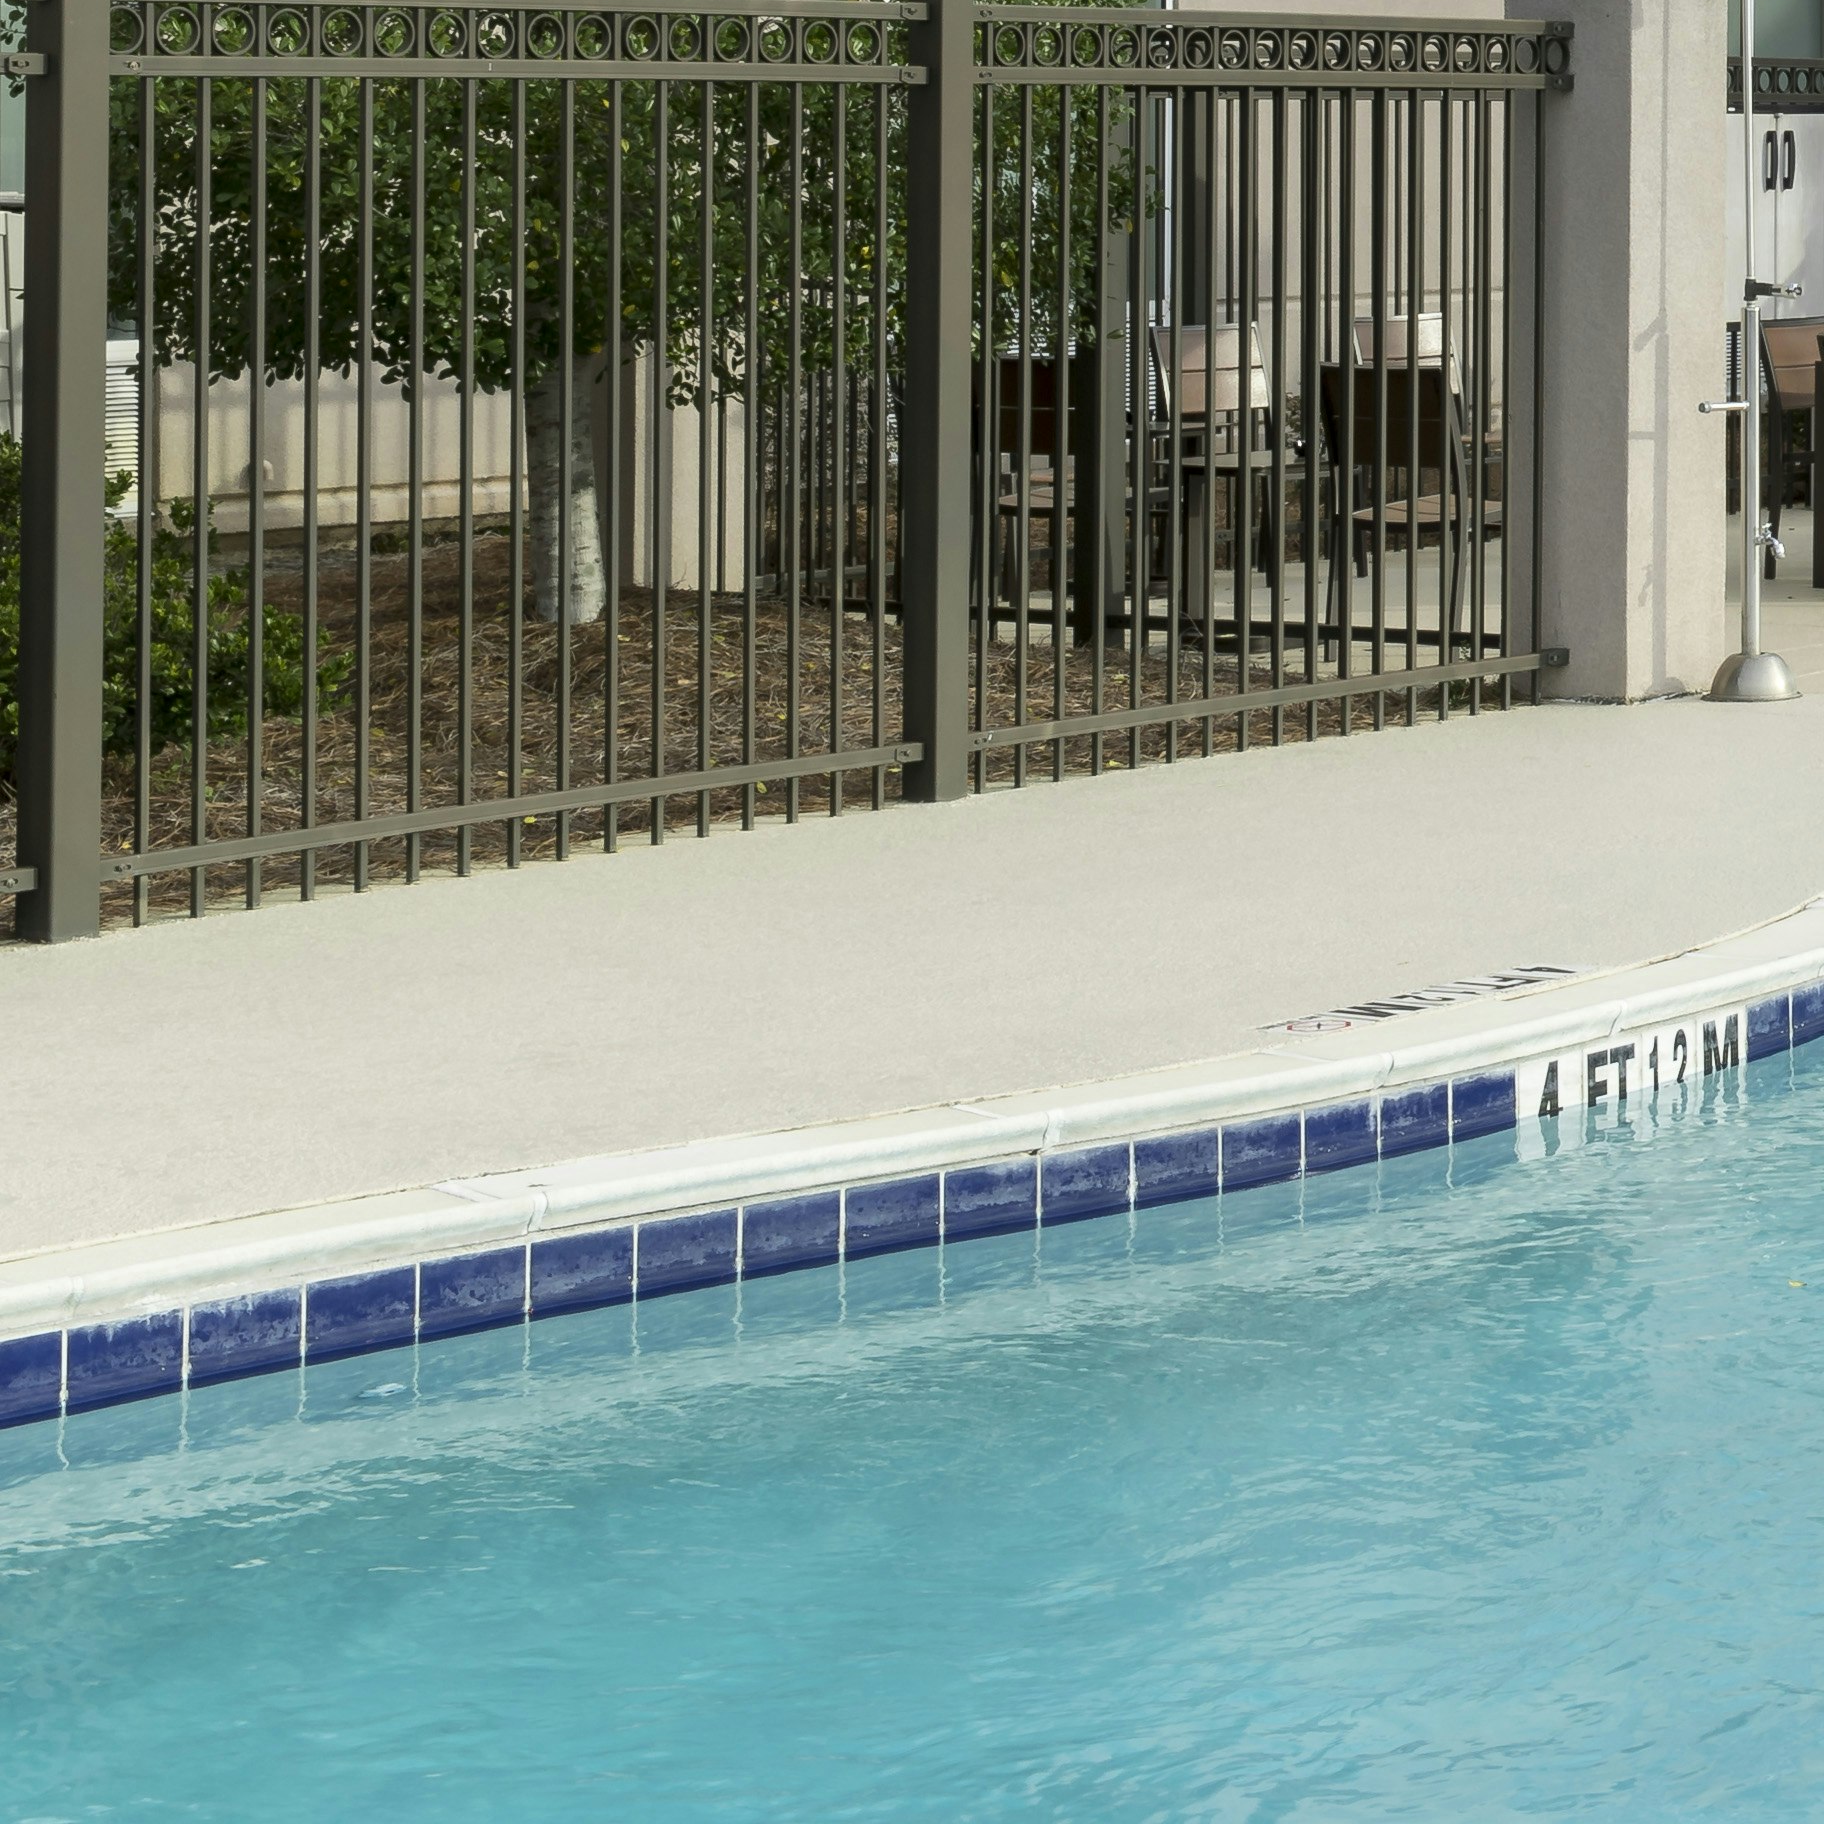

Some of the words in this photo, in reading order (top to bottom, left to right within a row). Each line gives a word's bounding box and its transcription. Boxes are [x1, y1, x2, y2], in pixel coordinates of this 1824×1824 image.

[1537, 1059, 1564, 1118] 4
[1587, 1042, 1636, 1108] FT
[1702, 1013, 1740, 1077] M
